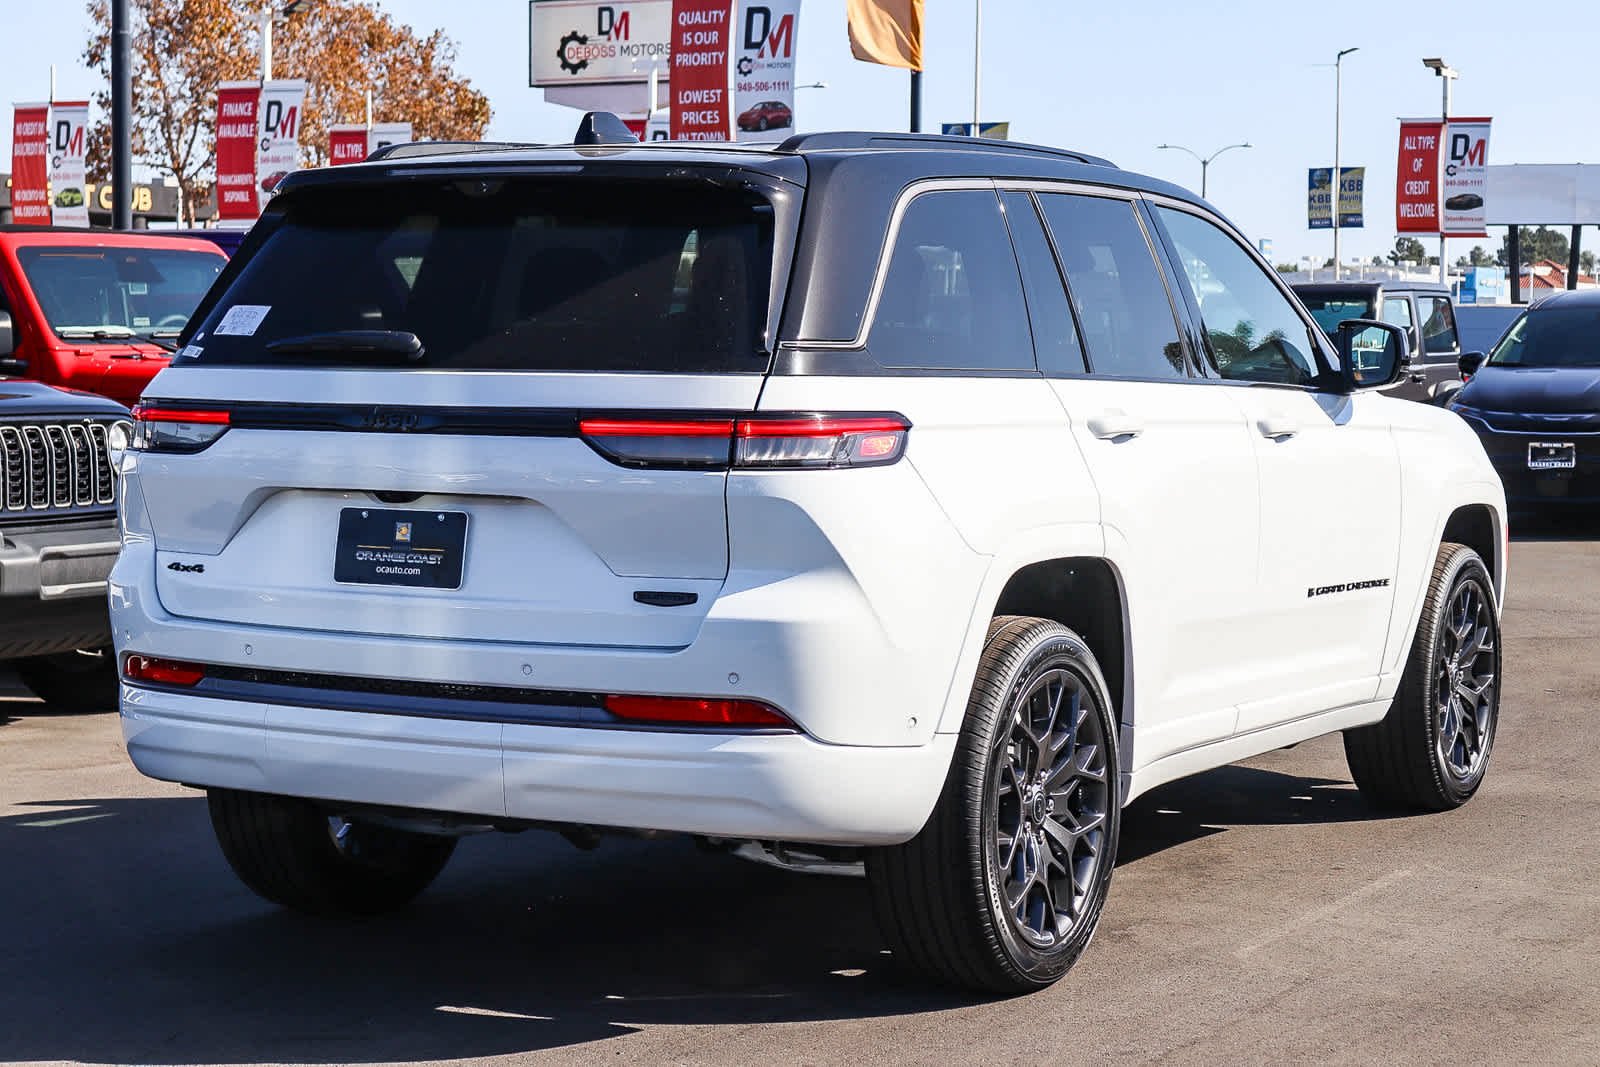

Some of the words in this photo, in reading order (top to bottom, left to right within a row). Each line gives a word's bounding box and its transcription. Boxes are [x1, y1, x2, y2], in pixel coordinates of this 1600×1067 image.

[678, 10, 726, 25] QUALITY
[682, 32, 693, 46] IS
[694, 31, 719, 44] OUR
[567, 45, 616, 60] DEBOSS
[620, 43, 671, 57] MOTORS
[676, 51, 725, 67] PRIORITY
[737, 80, 790, 92] 949-506-1111
[679, 89, 722, 104] LOWEST
[222, 101, 253, 118] FINANCE
[682, 110, 720, 125] PRICES
[218, 123, 255, 139] AVAILABLE
[678, 131, 689, 141] IN
[690, 131, 726, 141] TOWN
[334, 143, 346, 158] ALL
[347, 143, 363, 158] TYPE
[1404, 136, 1417, 150] ALL
[1418, 136, 1435, 150] TYPE
[1413, 158, 1423, 173] OF
[1405, 180, 1430, 195] CREDIT
[1400, 203, 1436, 218] WELCOME
[355, 551, 405, 563] ORANGE
[406, 553, 443, 565] COAST
[167, 562, 205, 573] 4x4
[375, 566, 421, 576] ocauto.com
[1315, 583, 1345, 596] GRAND
[1346, 578, 1390, 591] CHEROKEE
